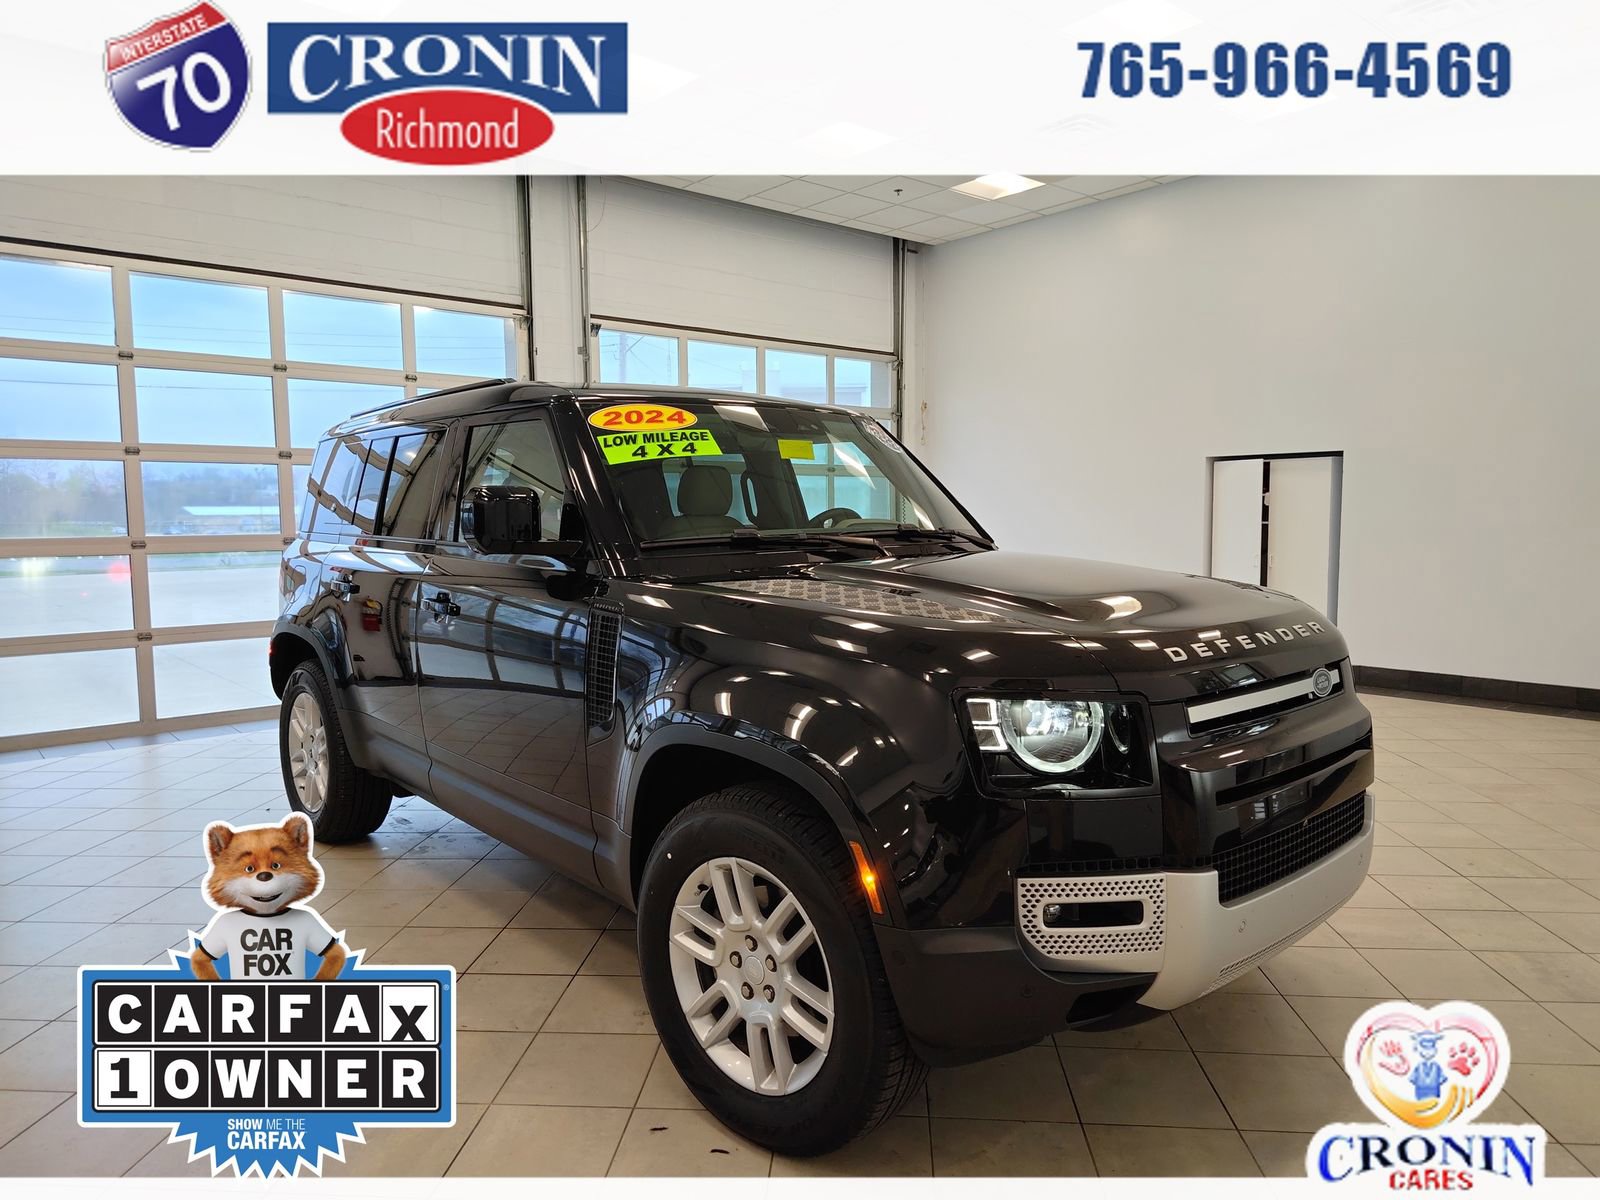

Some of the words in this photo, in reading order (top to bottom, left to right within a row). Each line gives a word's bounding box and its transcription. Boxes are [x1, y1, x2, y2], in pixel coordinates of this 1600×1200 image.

[603, 410, 686, 426] 2024
[604, 434, 637, 448] LOW
[643, 432, 708, 444] MILEAGE
[632, 446, 647, 457] 4
[657, 444, 674, 456] X
[682, 443, 697, 454] 4
[1163, 620, 1326, 663] DEFENDER
